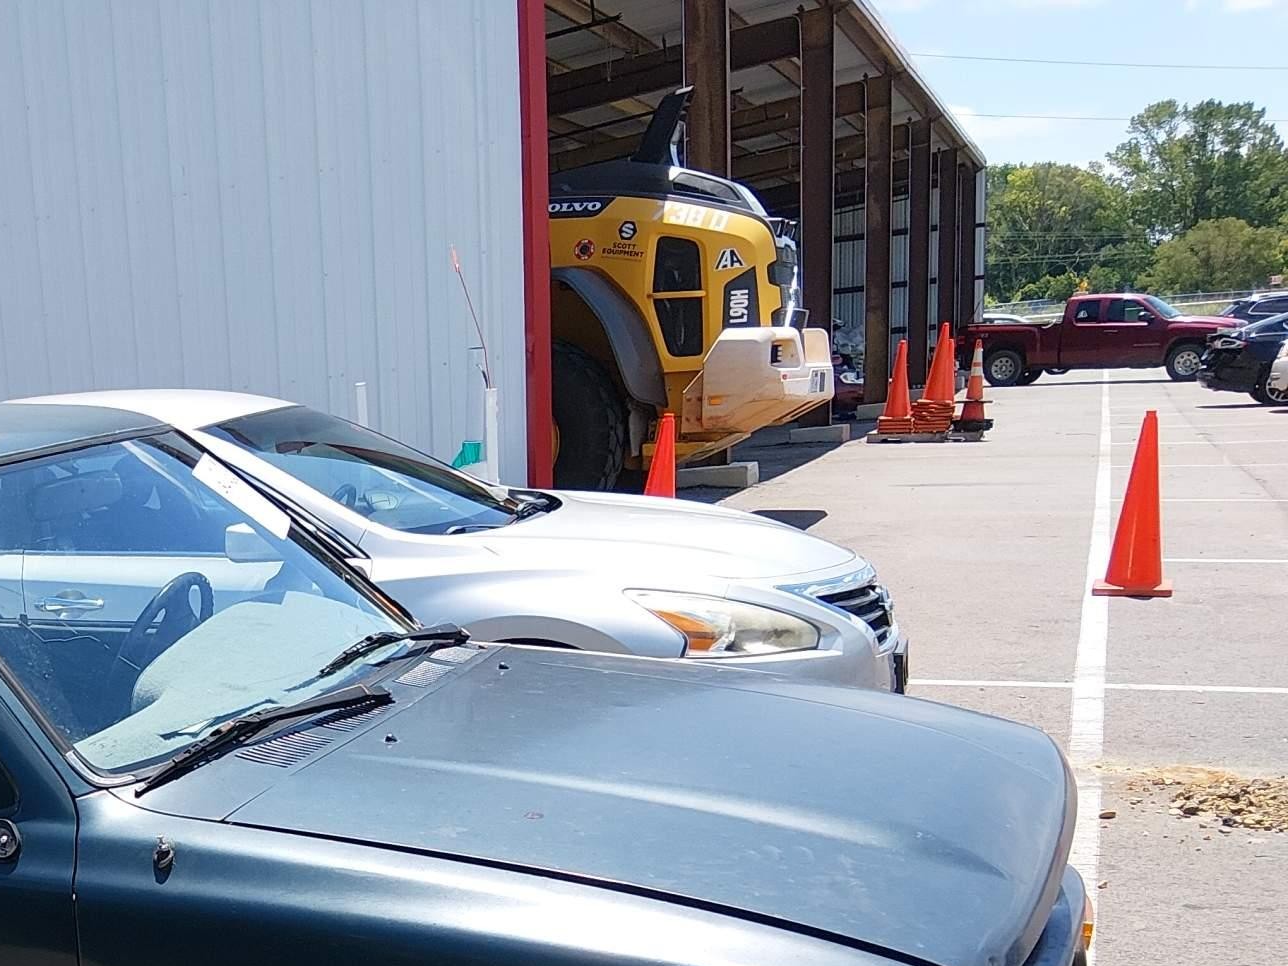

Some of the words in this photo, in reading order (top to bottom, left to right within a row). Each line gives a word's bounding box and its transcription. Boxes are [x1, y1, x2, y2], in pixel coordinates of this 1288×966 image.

[548, 201, 602, 213] OLVO
[612, 242, 637, 250] SCOTT
[602, 247, 644, 258] EQUIPMENT
[729, 289, 749, 324] L90H
